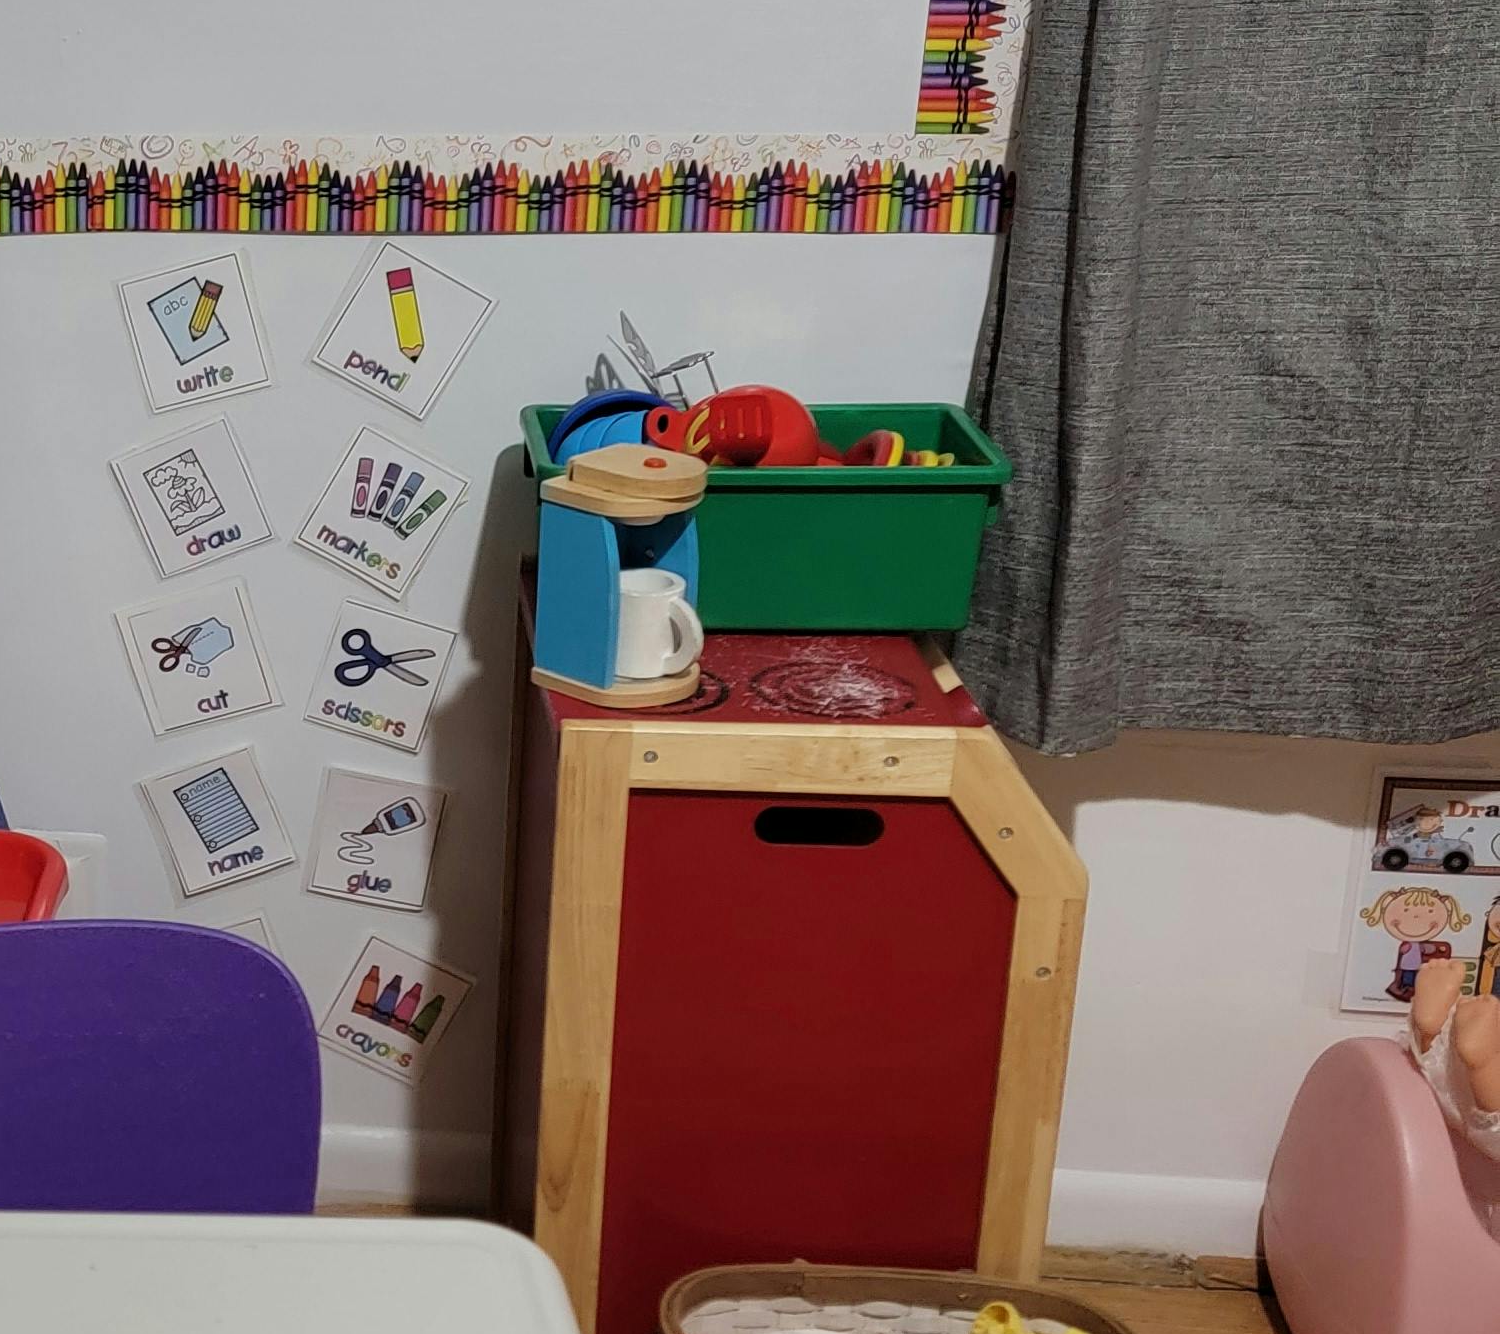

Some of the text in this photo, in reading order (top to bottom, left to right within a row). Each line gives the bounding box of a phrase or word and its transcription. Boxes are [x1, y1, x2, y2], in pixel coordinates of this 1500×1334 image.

[163, 295, 189, 316] abc
[176, 365, 234, 395] write
[186, 523, 242, 557] draw
[316, 524, 402, 581] markers
[197, 689, 230, 715] cut
[322, 698, 407, 738] scissors
[188, 776, 221, 797] name
[1445, 799, 1500, 818] Dra
[207, 845, 264, 877] name
[346, 869, 393, 895] glue
[335, 1020, 414, 1068] crayons
